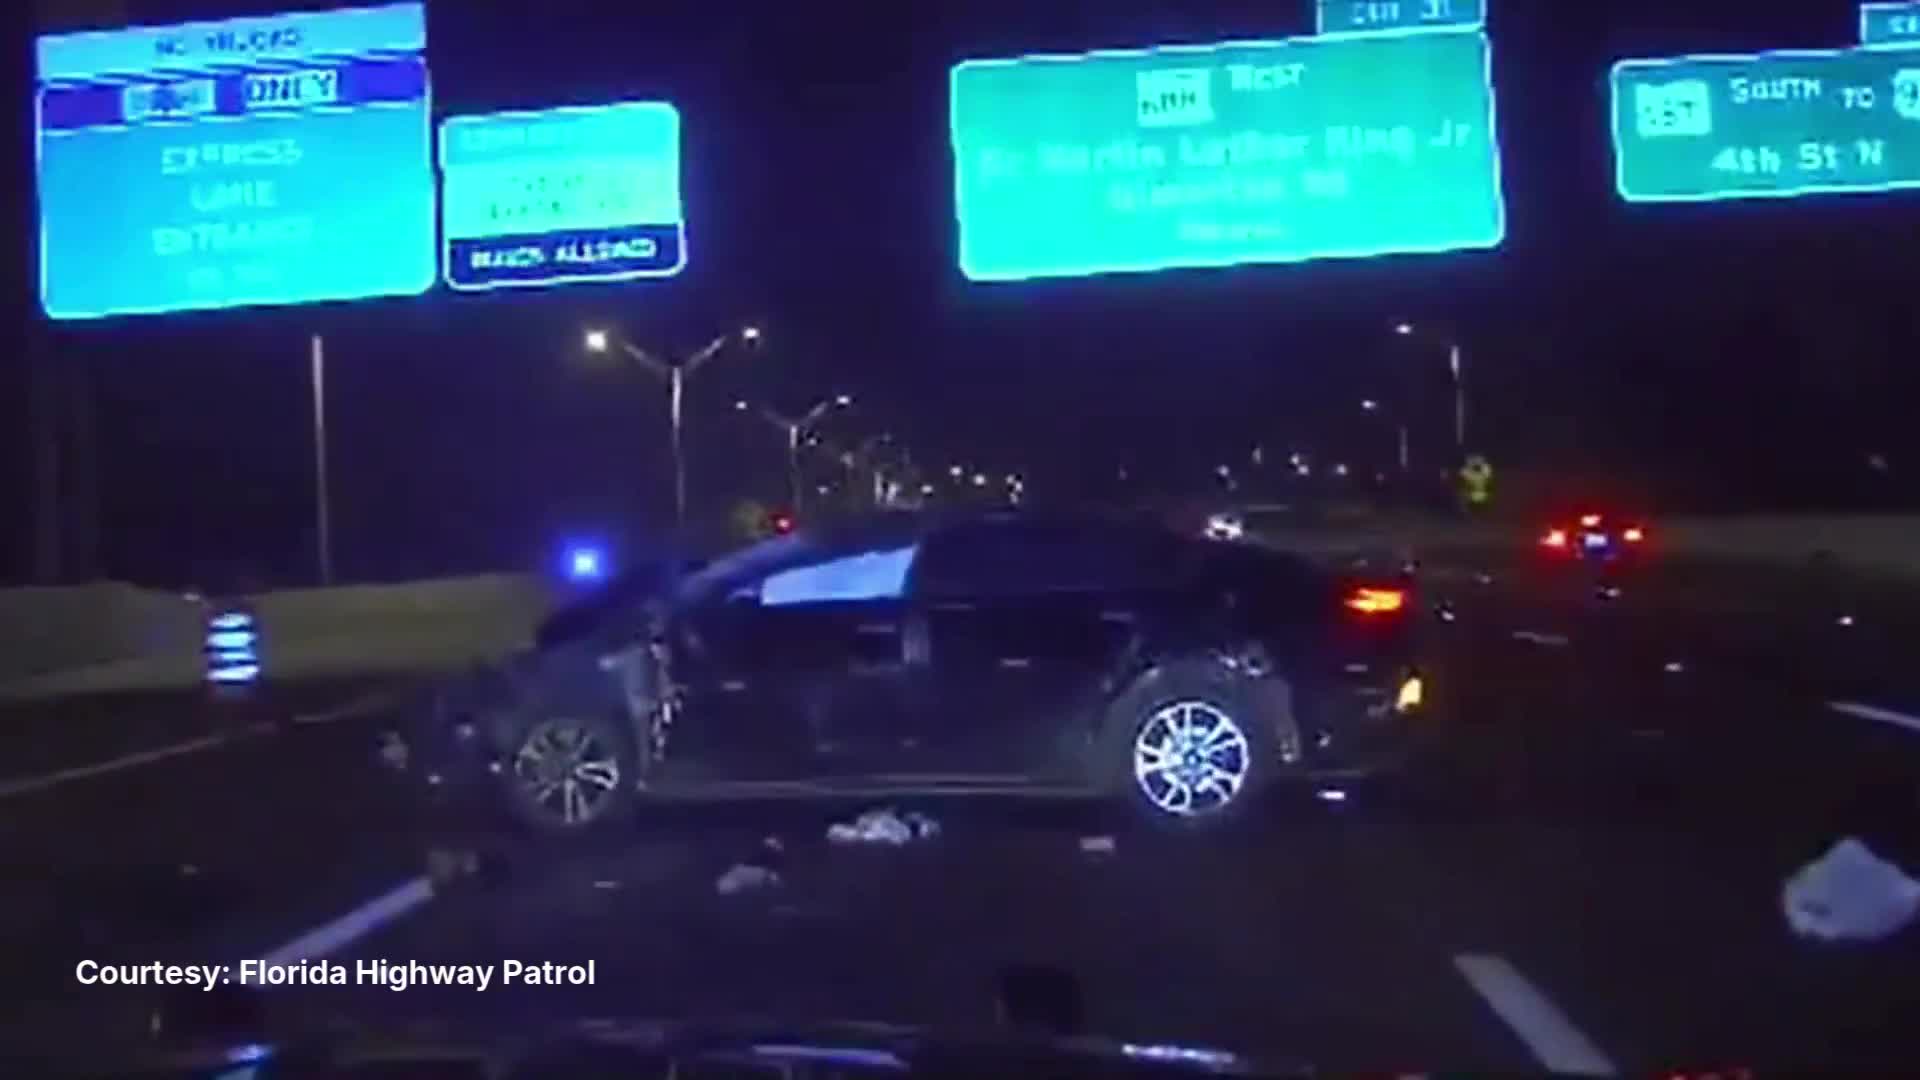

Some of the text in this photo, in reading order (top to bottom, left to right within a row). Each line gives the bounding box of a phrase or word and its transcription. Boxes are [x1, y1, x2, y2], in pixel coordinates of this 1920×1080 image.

[1429, 117, 1472, 149] Jr
[1710, 140, 1884, 173] 4th St N
